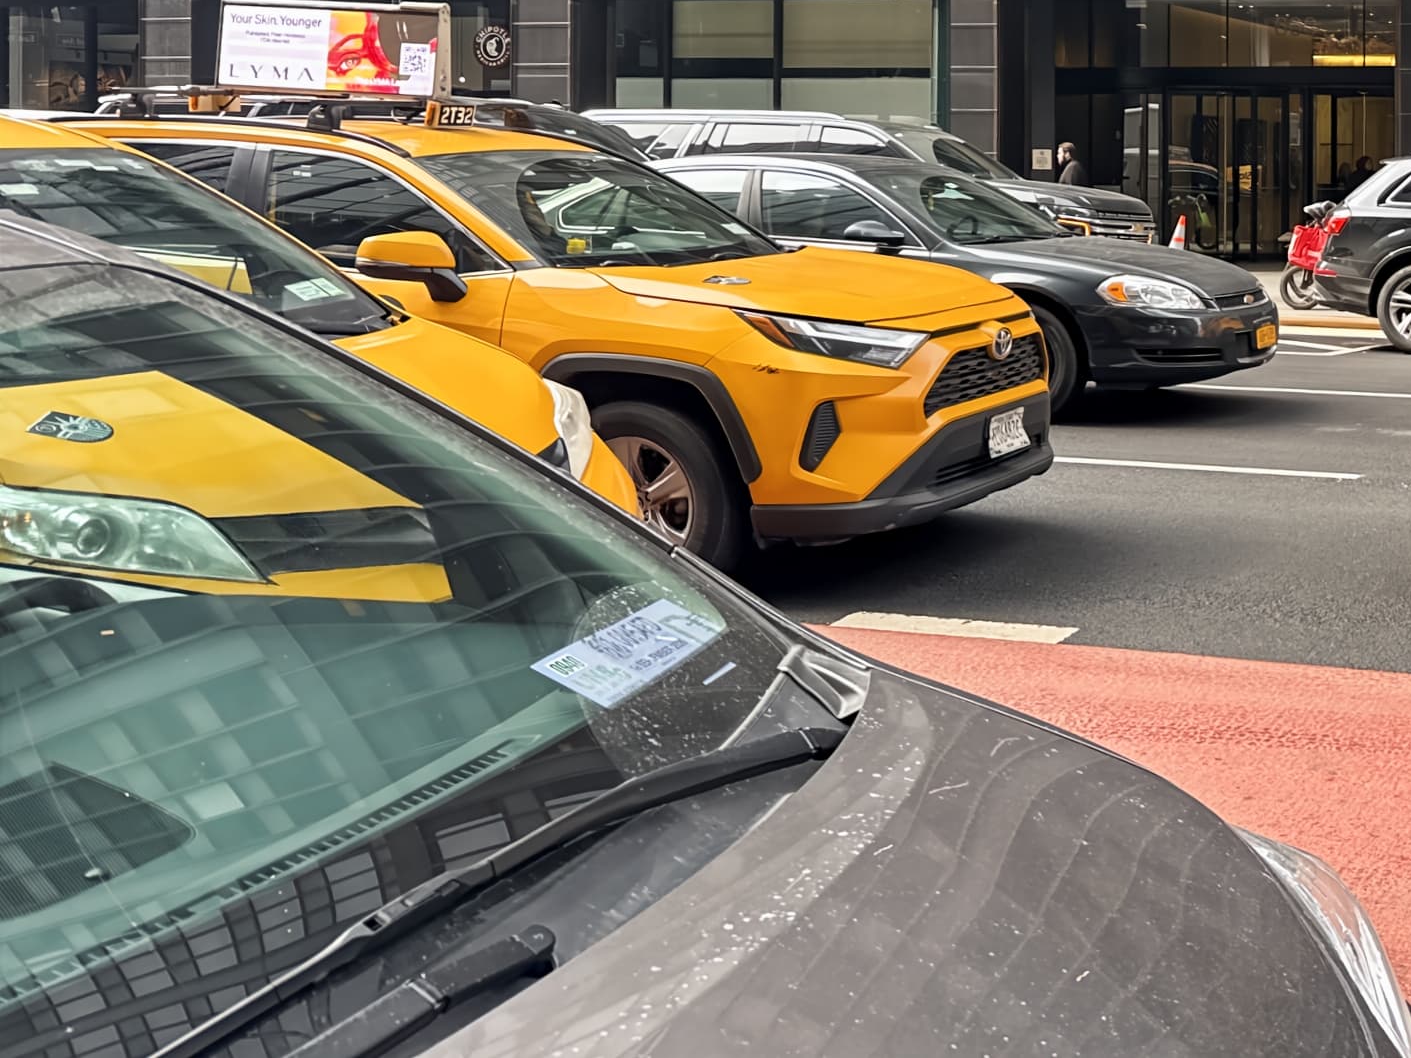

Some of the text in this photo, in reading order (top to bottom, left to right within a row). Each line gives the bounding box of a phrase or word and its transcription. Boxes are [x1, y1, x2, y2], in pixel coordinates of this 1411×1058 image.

[231, 13, 253, 24] Your
[280, 16, 322, 29] Younger
[475, 25, 511, 44] CHIPOTLE
[229, 63, 315, 82] LYMA
[441, 106, 473, 124] 2T32
